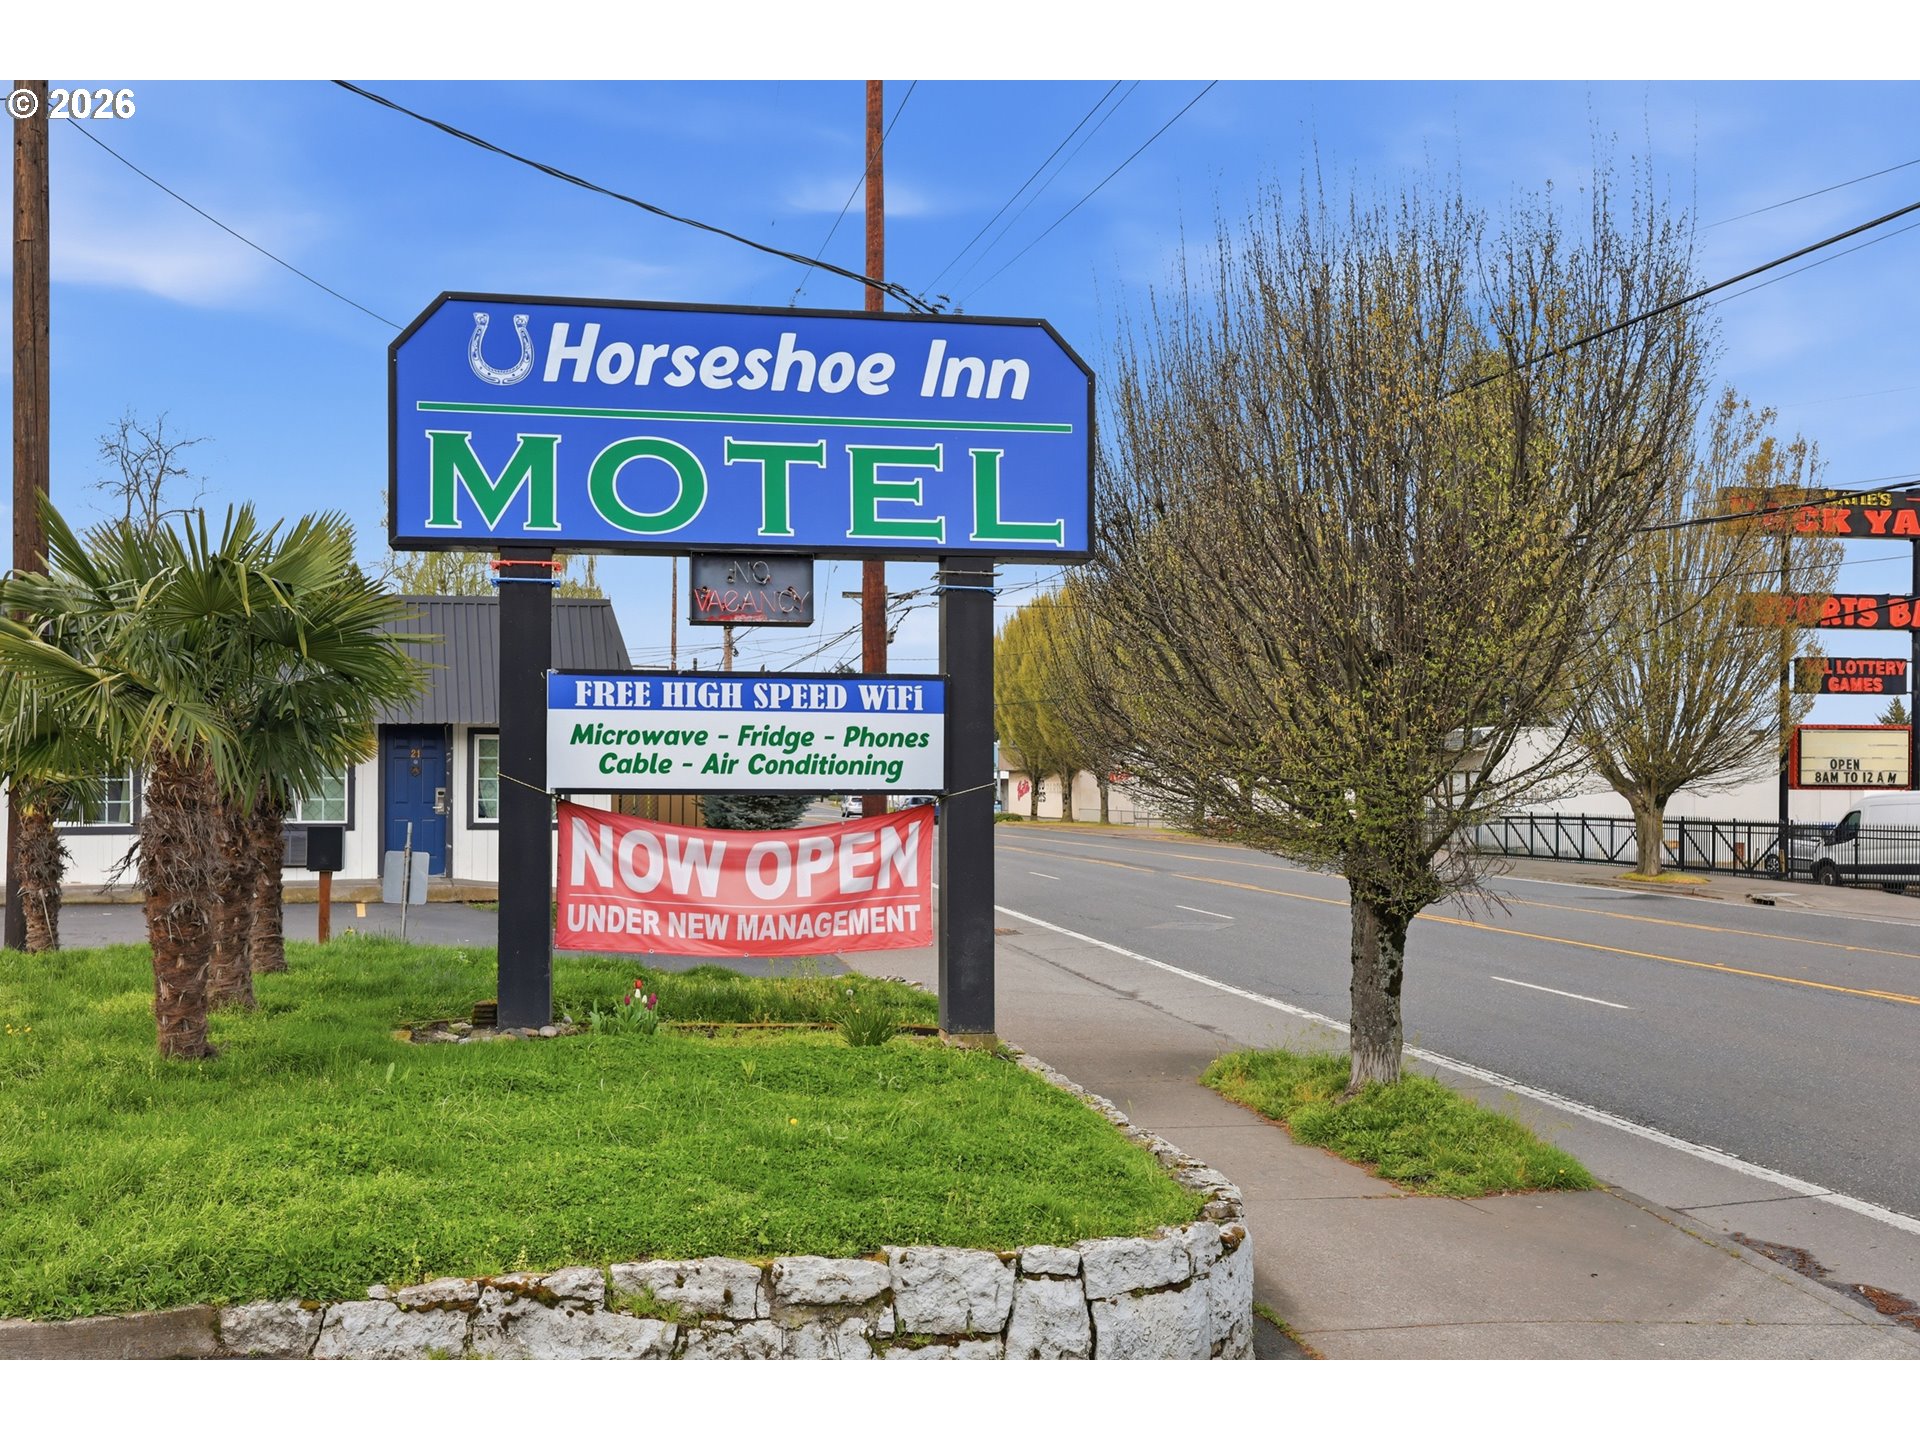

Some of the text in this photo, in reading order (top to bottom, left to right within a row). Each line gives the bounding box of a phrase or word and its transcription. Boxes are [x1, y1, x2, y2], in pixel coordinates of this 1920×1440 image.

[543, 321, 1031, 401] Horseshoe Inn
[424, 429, 1065, 548] MOTEL
[733, 560, 769, 585] NO
[693, 588, 811, 613] VACANCY
[1836, 659, 1907, 676] LOTTERY
[575, 680, 924, 712] FREE HIGH SPEED WiFi
[1827, 677, 1884, 693] GAMES
[570, 722, 709, 747] Microwave
[737, 724, 815, 755] Fridge
[843, 726, 930, 748] Phones
[410, 749, 421, 759] 21
[598, 752, 673, 775] Cable
[701, 753, 739, 775] Air
[748, 753, 904, 783] Conditioning
[1829, 759, 1861, 771] OPEN
[1814, 771, 1839, 783] 8AM
[1843, 771, 1858, 783] TO
[569, 816, 922, 901] NOW OPEN
[566, 903, 921, 942] UNDER NEW MANAGEMENT
